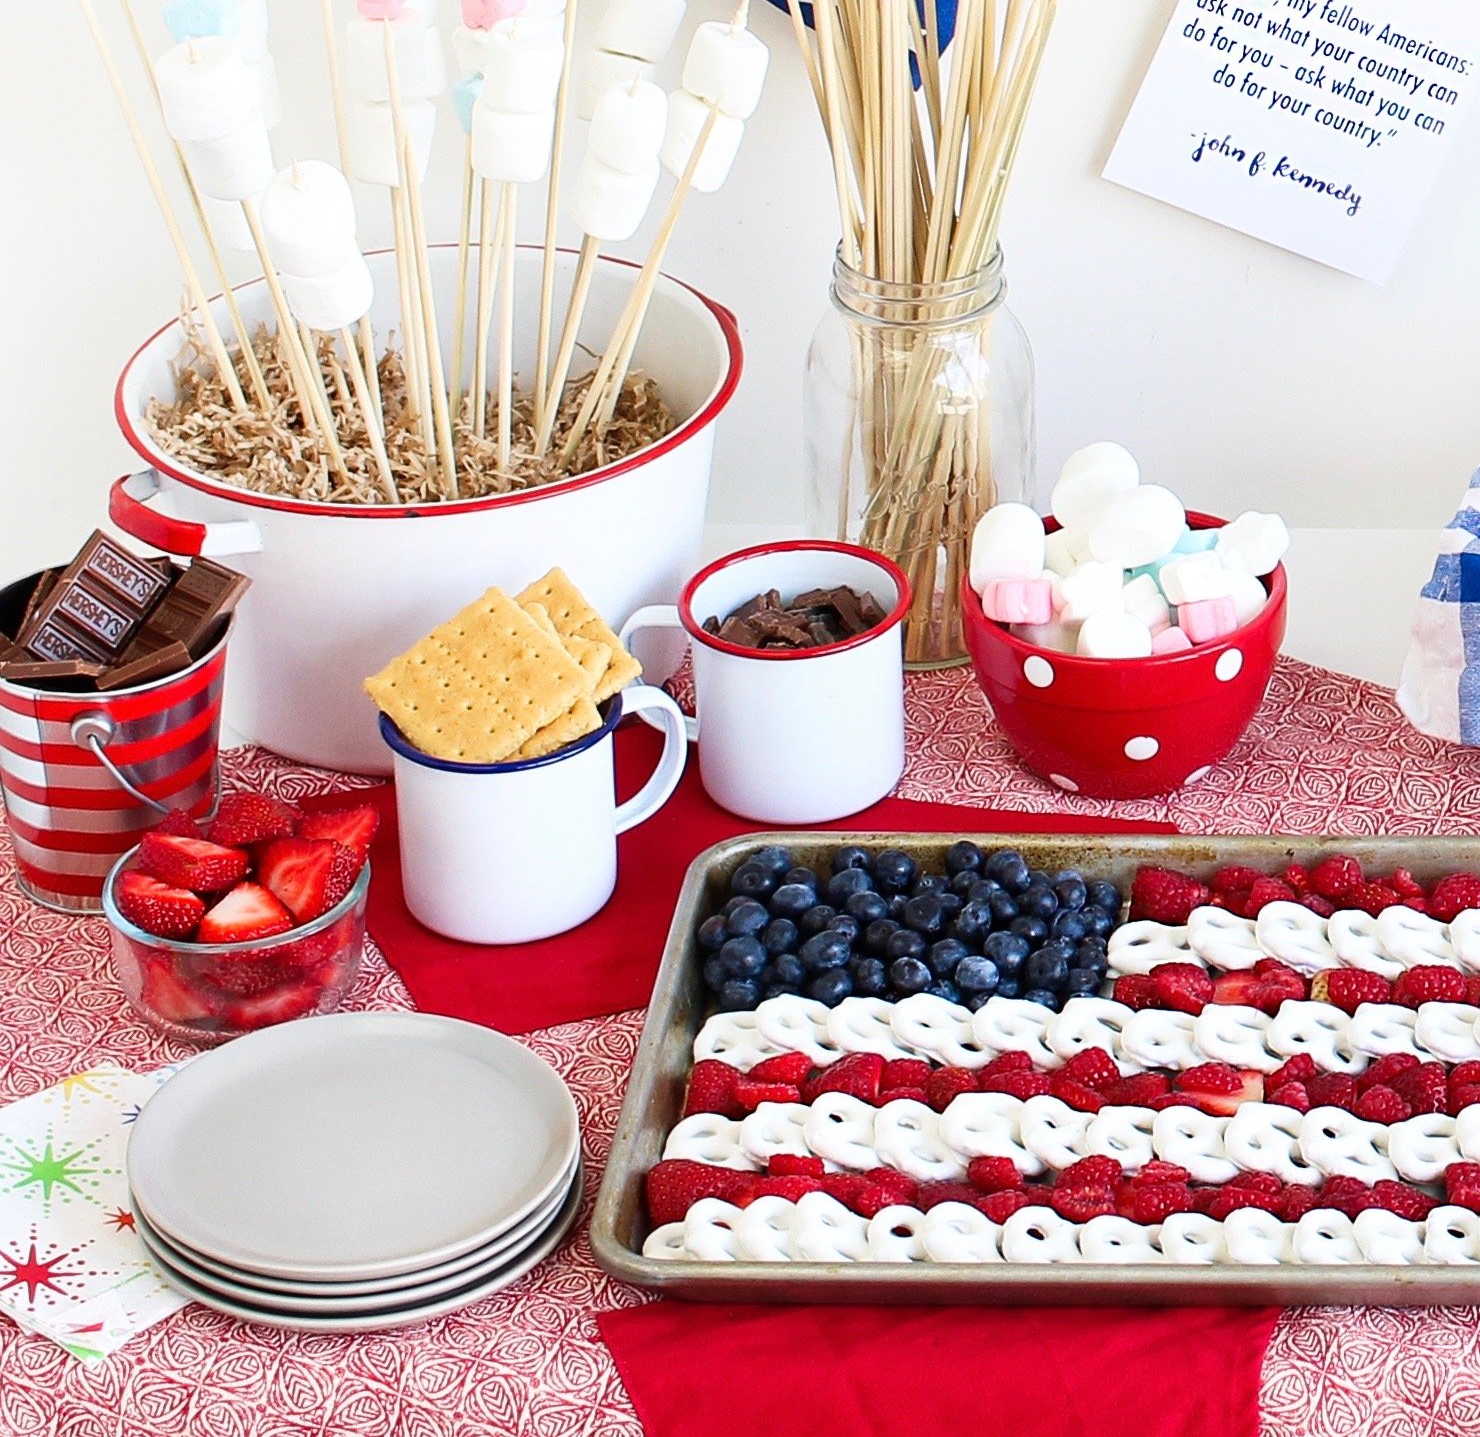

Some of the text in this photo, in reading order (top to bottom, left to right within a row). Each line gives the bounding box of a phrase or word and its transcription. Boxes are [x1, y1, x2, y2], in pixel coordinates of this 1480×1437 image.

[1182, 17, 1206, 42] do
[1209, 25, 1238, 54] for
[1238, 44, 1274, 68] you
[1294, 65, 1327, 89] ask
[1331, 76, 1375, 107] what
[1374, 97, 1411, 121] you
[1414, 112, 1445, 135] can
[1231, 7, 1263, 29] not
[1266, 17, 1311, 48] what
[1310, 37, 1355, 64] your
[1357, 55, 1425, 96] country
[1427, 83, 1459, 106] can
[1375, 23, 1474, 75] Americans:
[1212, 63, 1236, 88] do
[1239, 71, 1268, 99] for
[1267, 90, 1312, 117] your
[1272, 156, 1362, 217] kennedy
[92, 548, 152, 598] HERSHEY'S
[65, 589, 123, 638] HERSHEY'S
